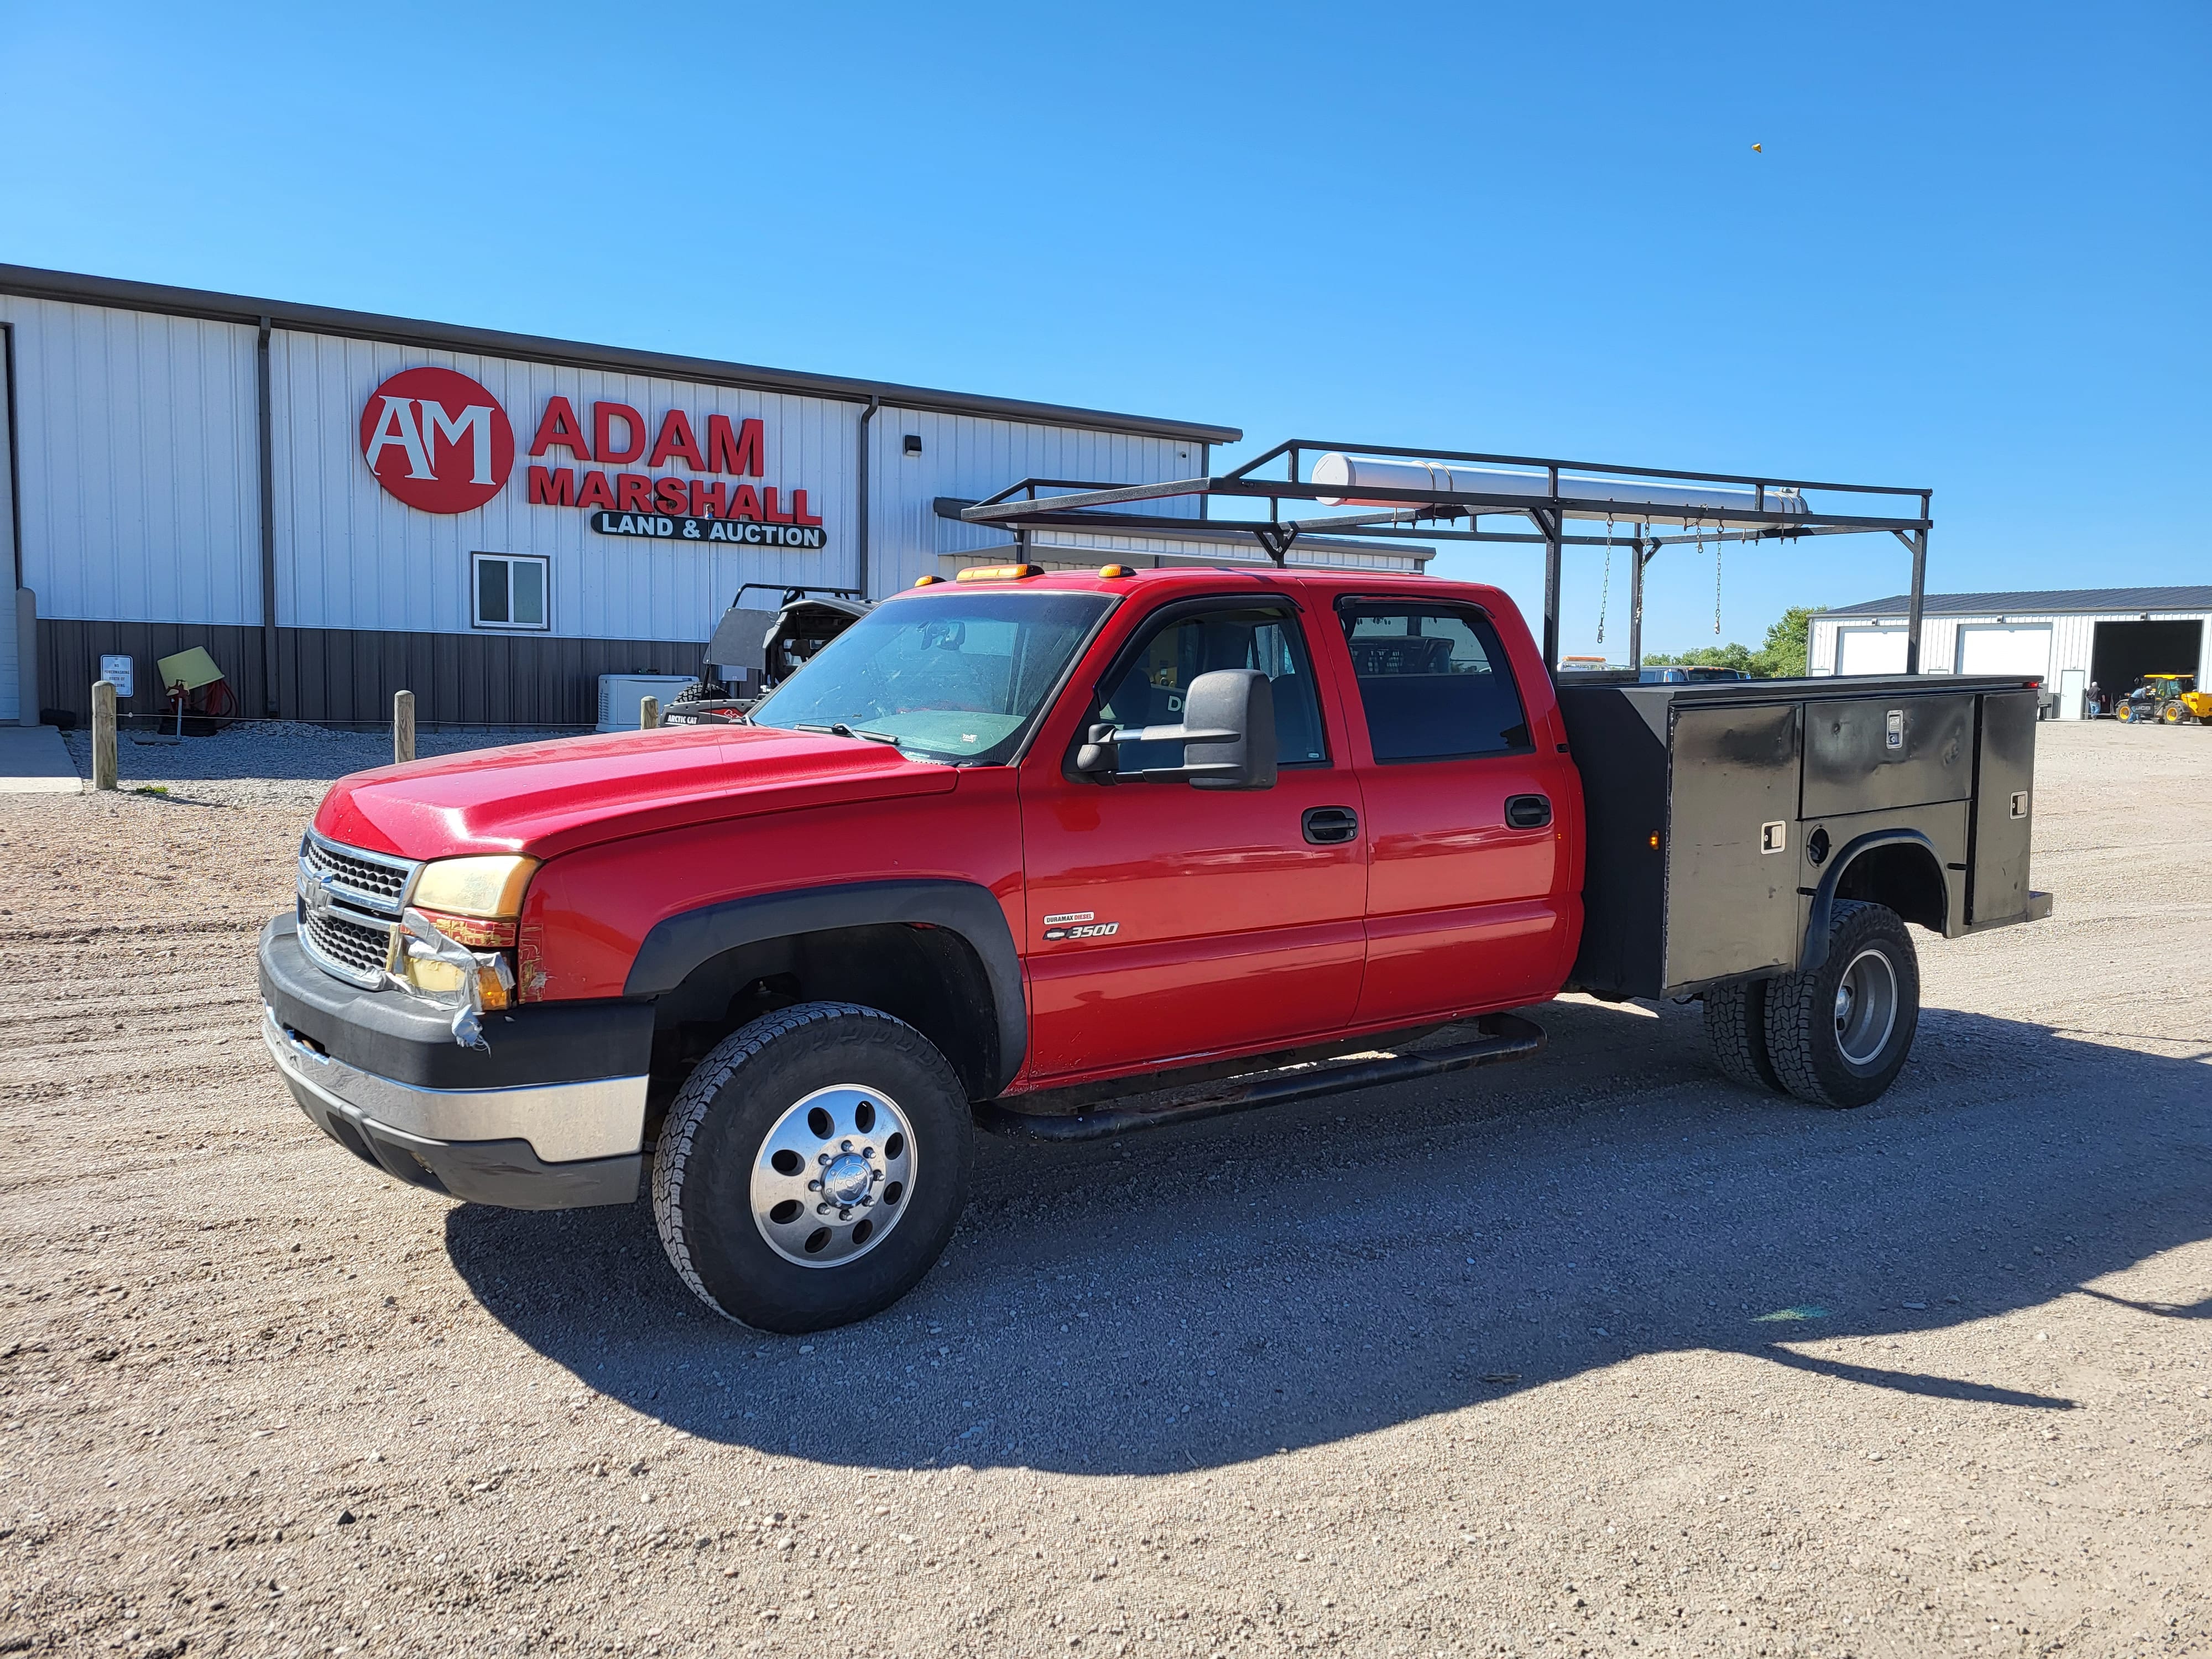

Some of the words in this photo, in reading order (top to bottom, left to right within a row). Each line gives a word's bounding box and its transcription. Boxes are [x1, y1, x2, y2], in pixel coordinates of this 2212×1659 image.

[366, 395, 496, 486] AM
[529, 395, 764, 477] ADAM
[528, 465, 823, 526] MARSHALL
[602, 513, 673, 536] LAND
[682, 520, 701, 539] &
[709, 521, 820, 547] AUCTION
[667, 714, 686, 724] ARCTIC
[687, 716, 698, 724] CAT
[1068, 922, 1119, 939] 3500
